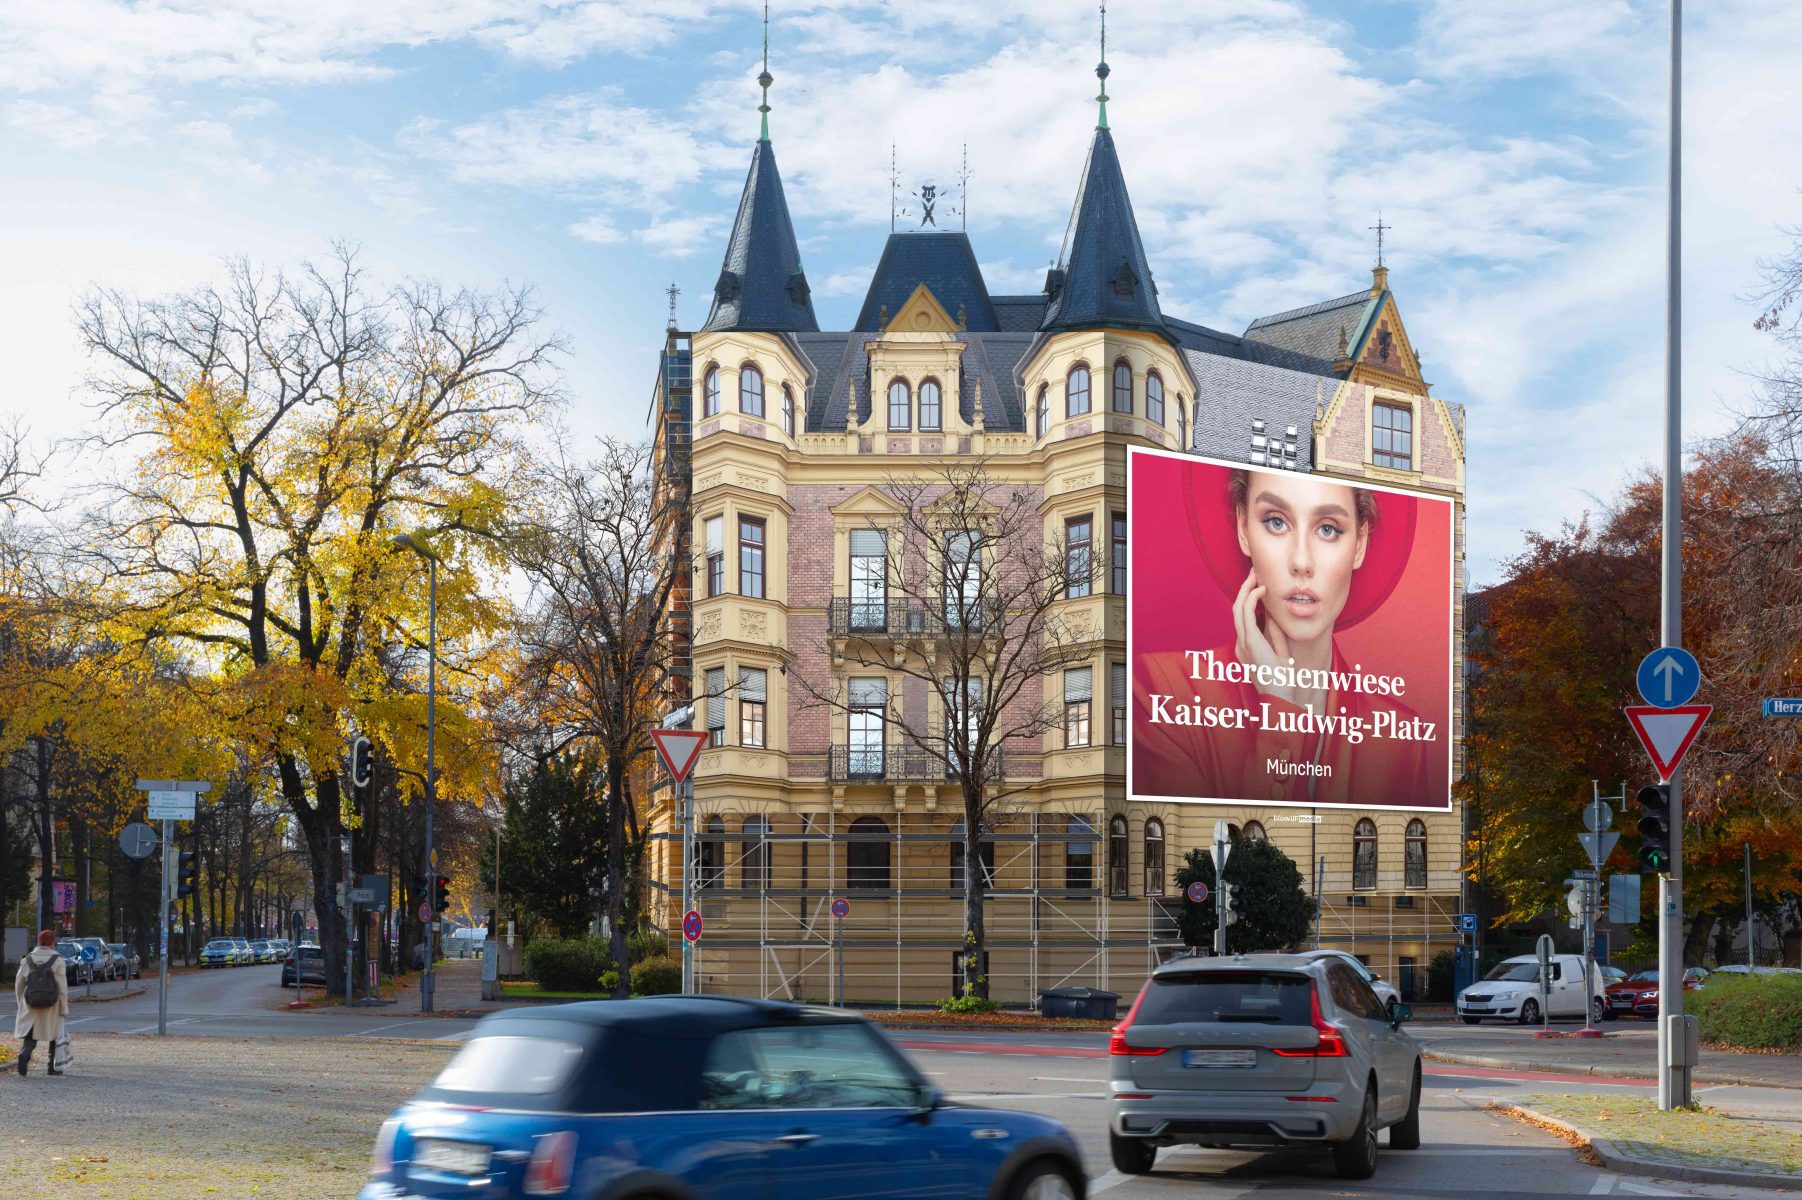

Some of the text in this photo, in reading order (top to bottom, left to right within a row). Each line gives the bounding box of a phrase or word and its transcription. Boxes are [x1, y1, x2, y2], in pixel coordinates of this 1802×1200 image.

[1185, 650, 1406, 698] Theresienwiese
[1148, 694, 1437, 744] Kaiser-Ludwig-Platz
[1266, 758, 1332, 777] München
